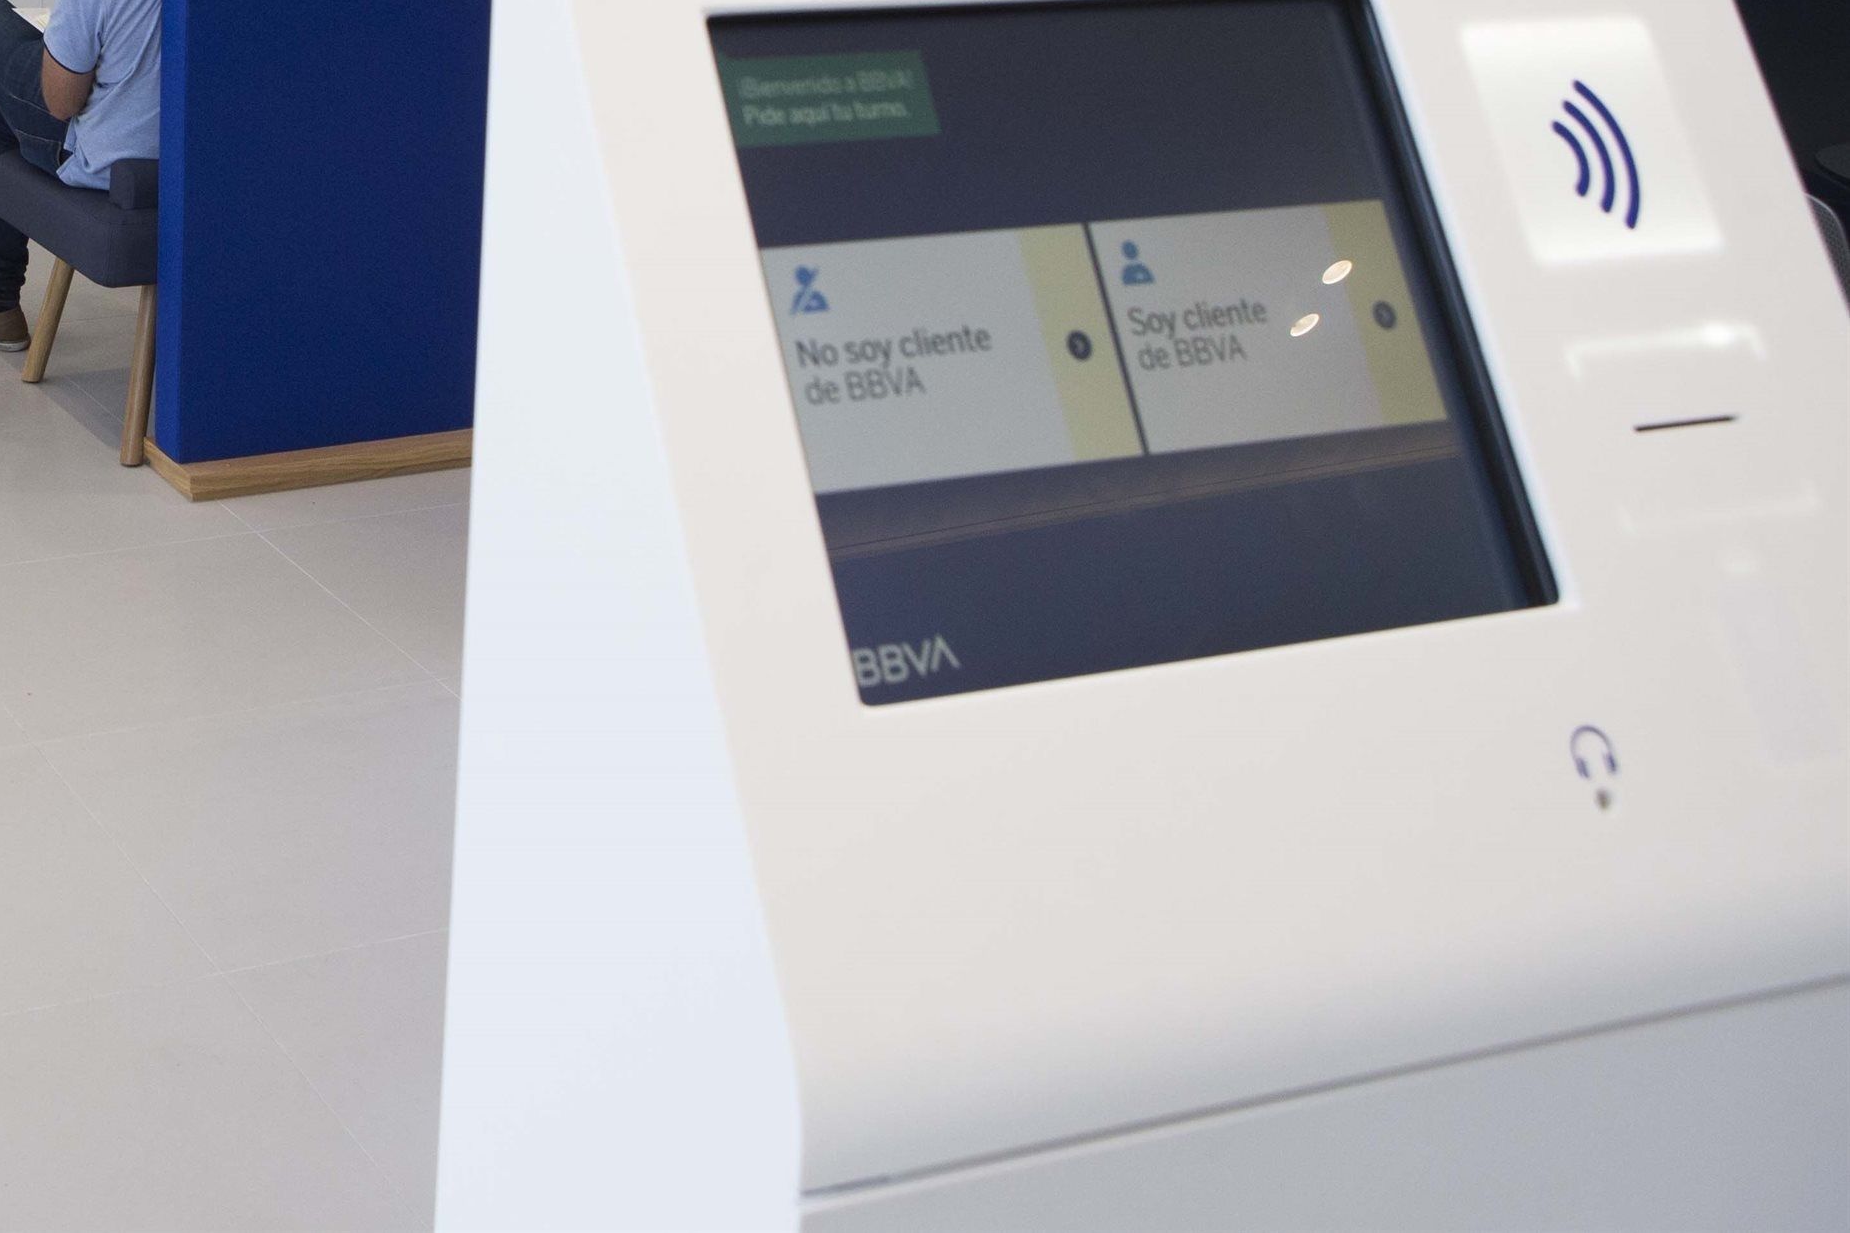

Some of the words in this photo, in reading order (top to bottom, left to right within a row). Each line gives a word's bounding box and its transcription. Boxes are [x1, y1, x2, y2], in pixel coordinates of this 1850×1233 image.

[1127, 305, 1176, 339] Soy
[1183, 297, 1268, 330] cliente
[795, 339, 839, 368] No
[843, 337, 893, 369] soy
[899, 324, 992, 359] cliente
[1138, 342, 1173, 370] de
[1175, 333, 1249, 367] BBVA
[804, 375, 841, 406] de
[844, 366, 926, 402] BBVA
[851, 633, 962, 688] BBVA
